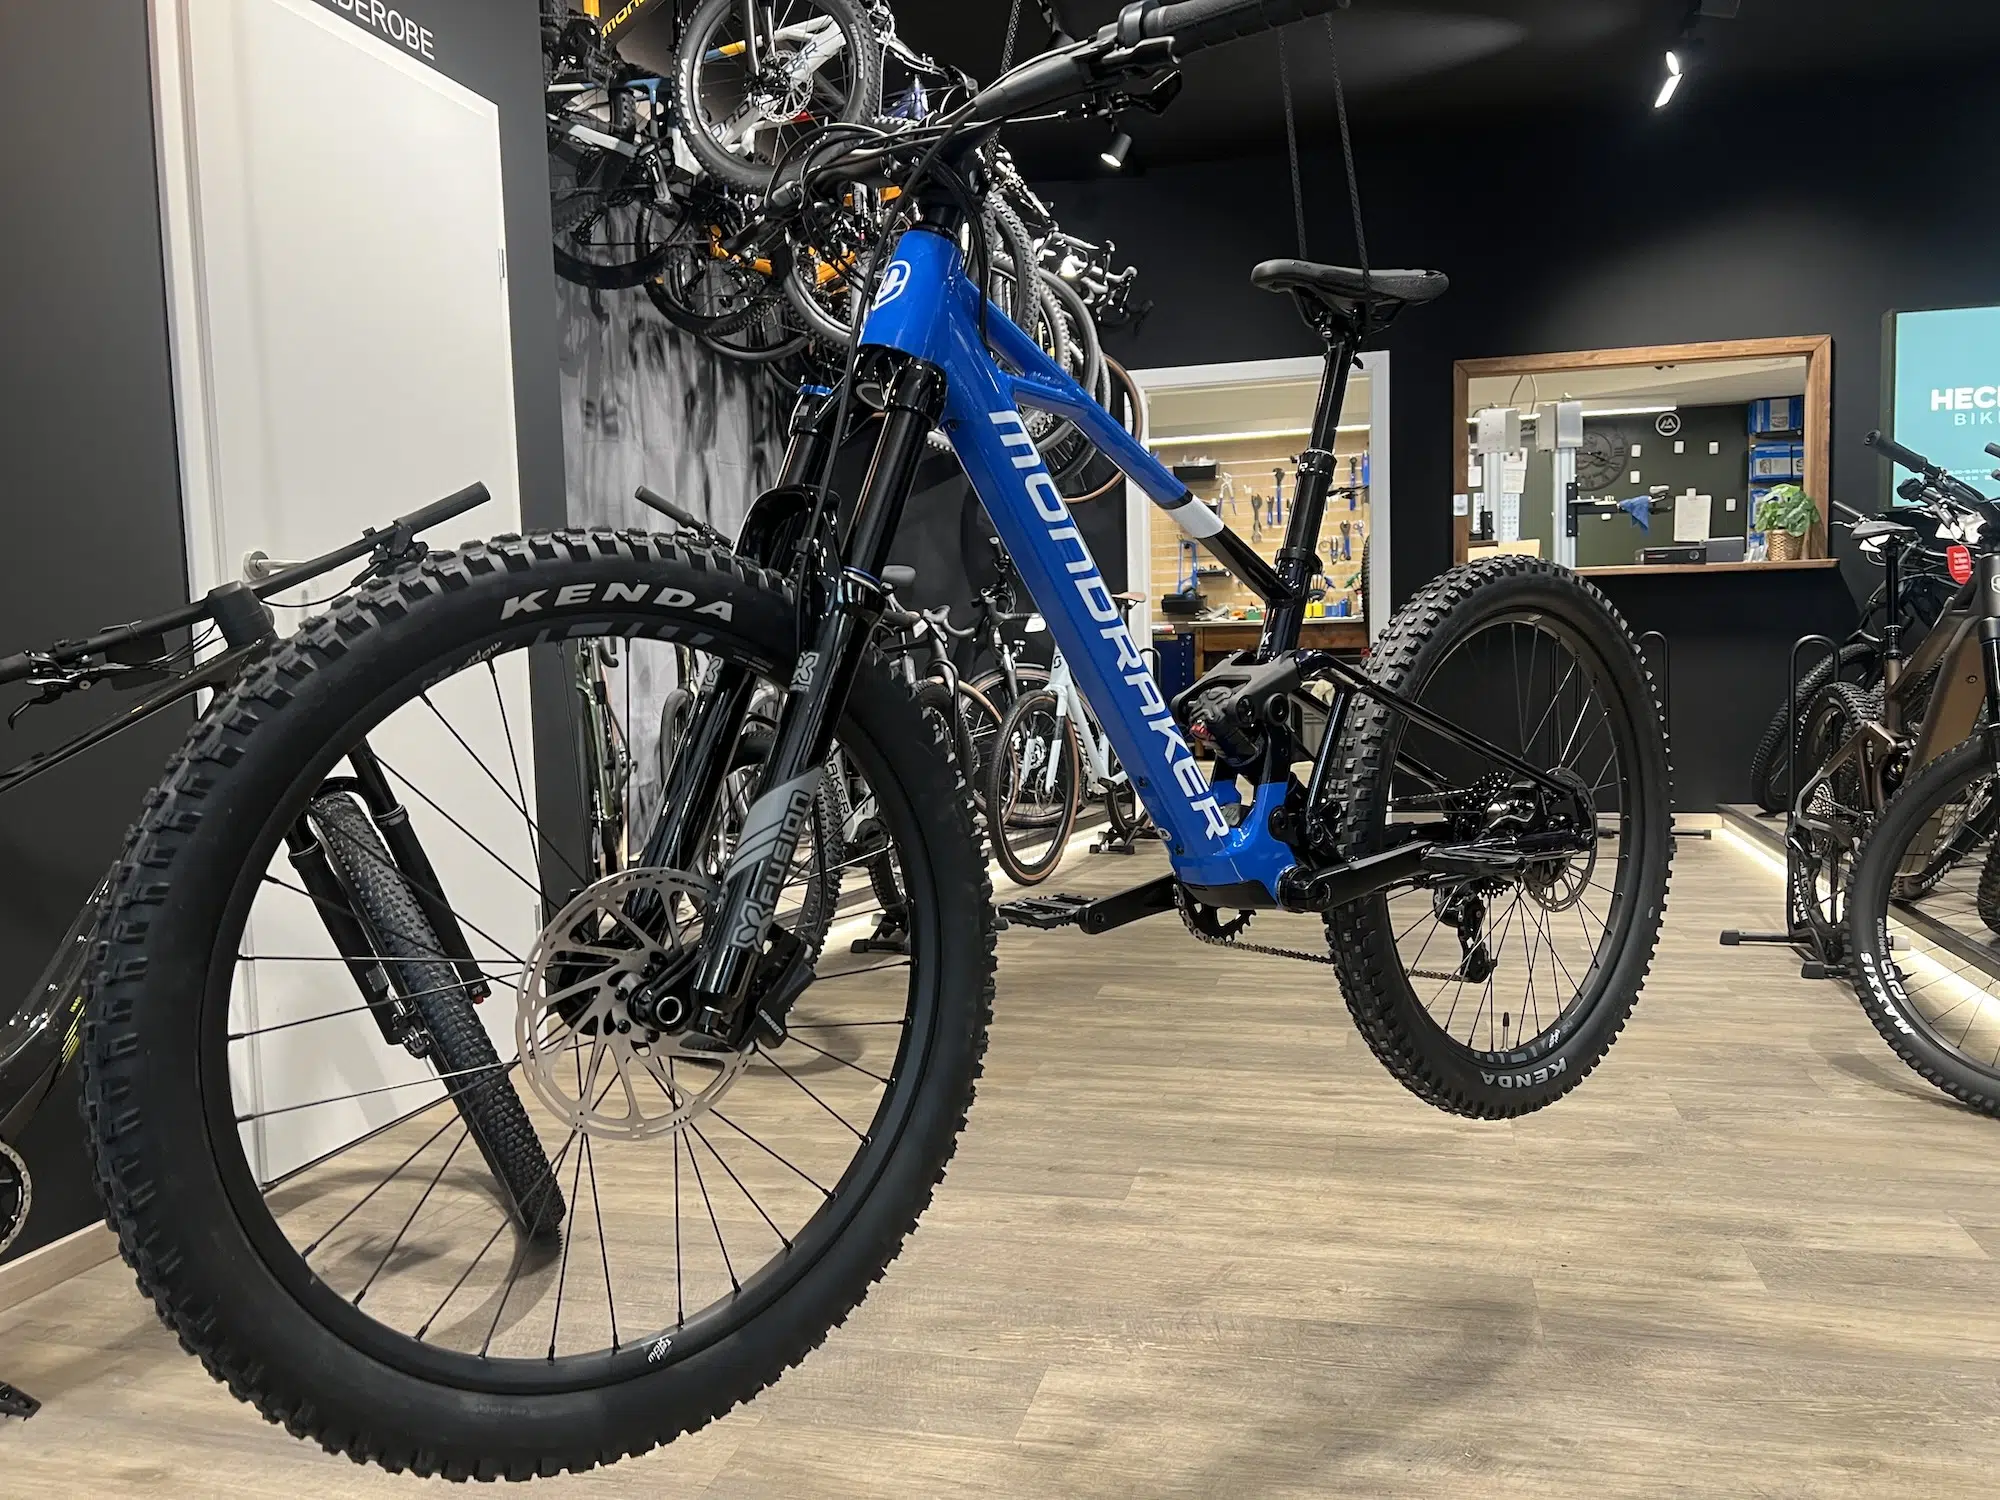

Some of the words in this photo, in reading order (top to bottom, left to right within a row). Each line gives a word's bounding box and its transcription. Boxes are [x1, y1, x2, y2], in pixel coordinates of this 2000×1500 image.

[332, 0, 435, 60] EROBE
[601, 0, 648, 38] mon
[1931, 385, 2000, 410] HEC
[1954, 411, 2000, 425] BIK
[500, 582, 734, 622] KENDA
[1860, 952, 1917, 1036] MAXXIS
[1480, 1057, 1568, 1089] KENDA
